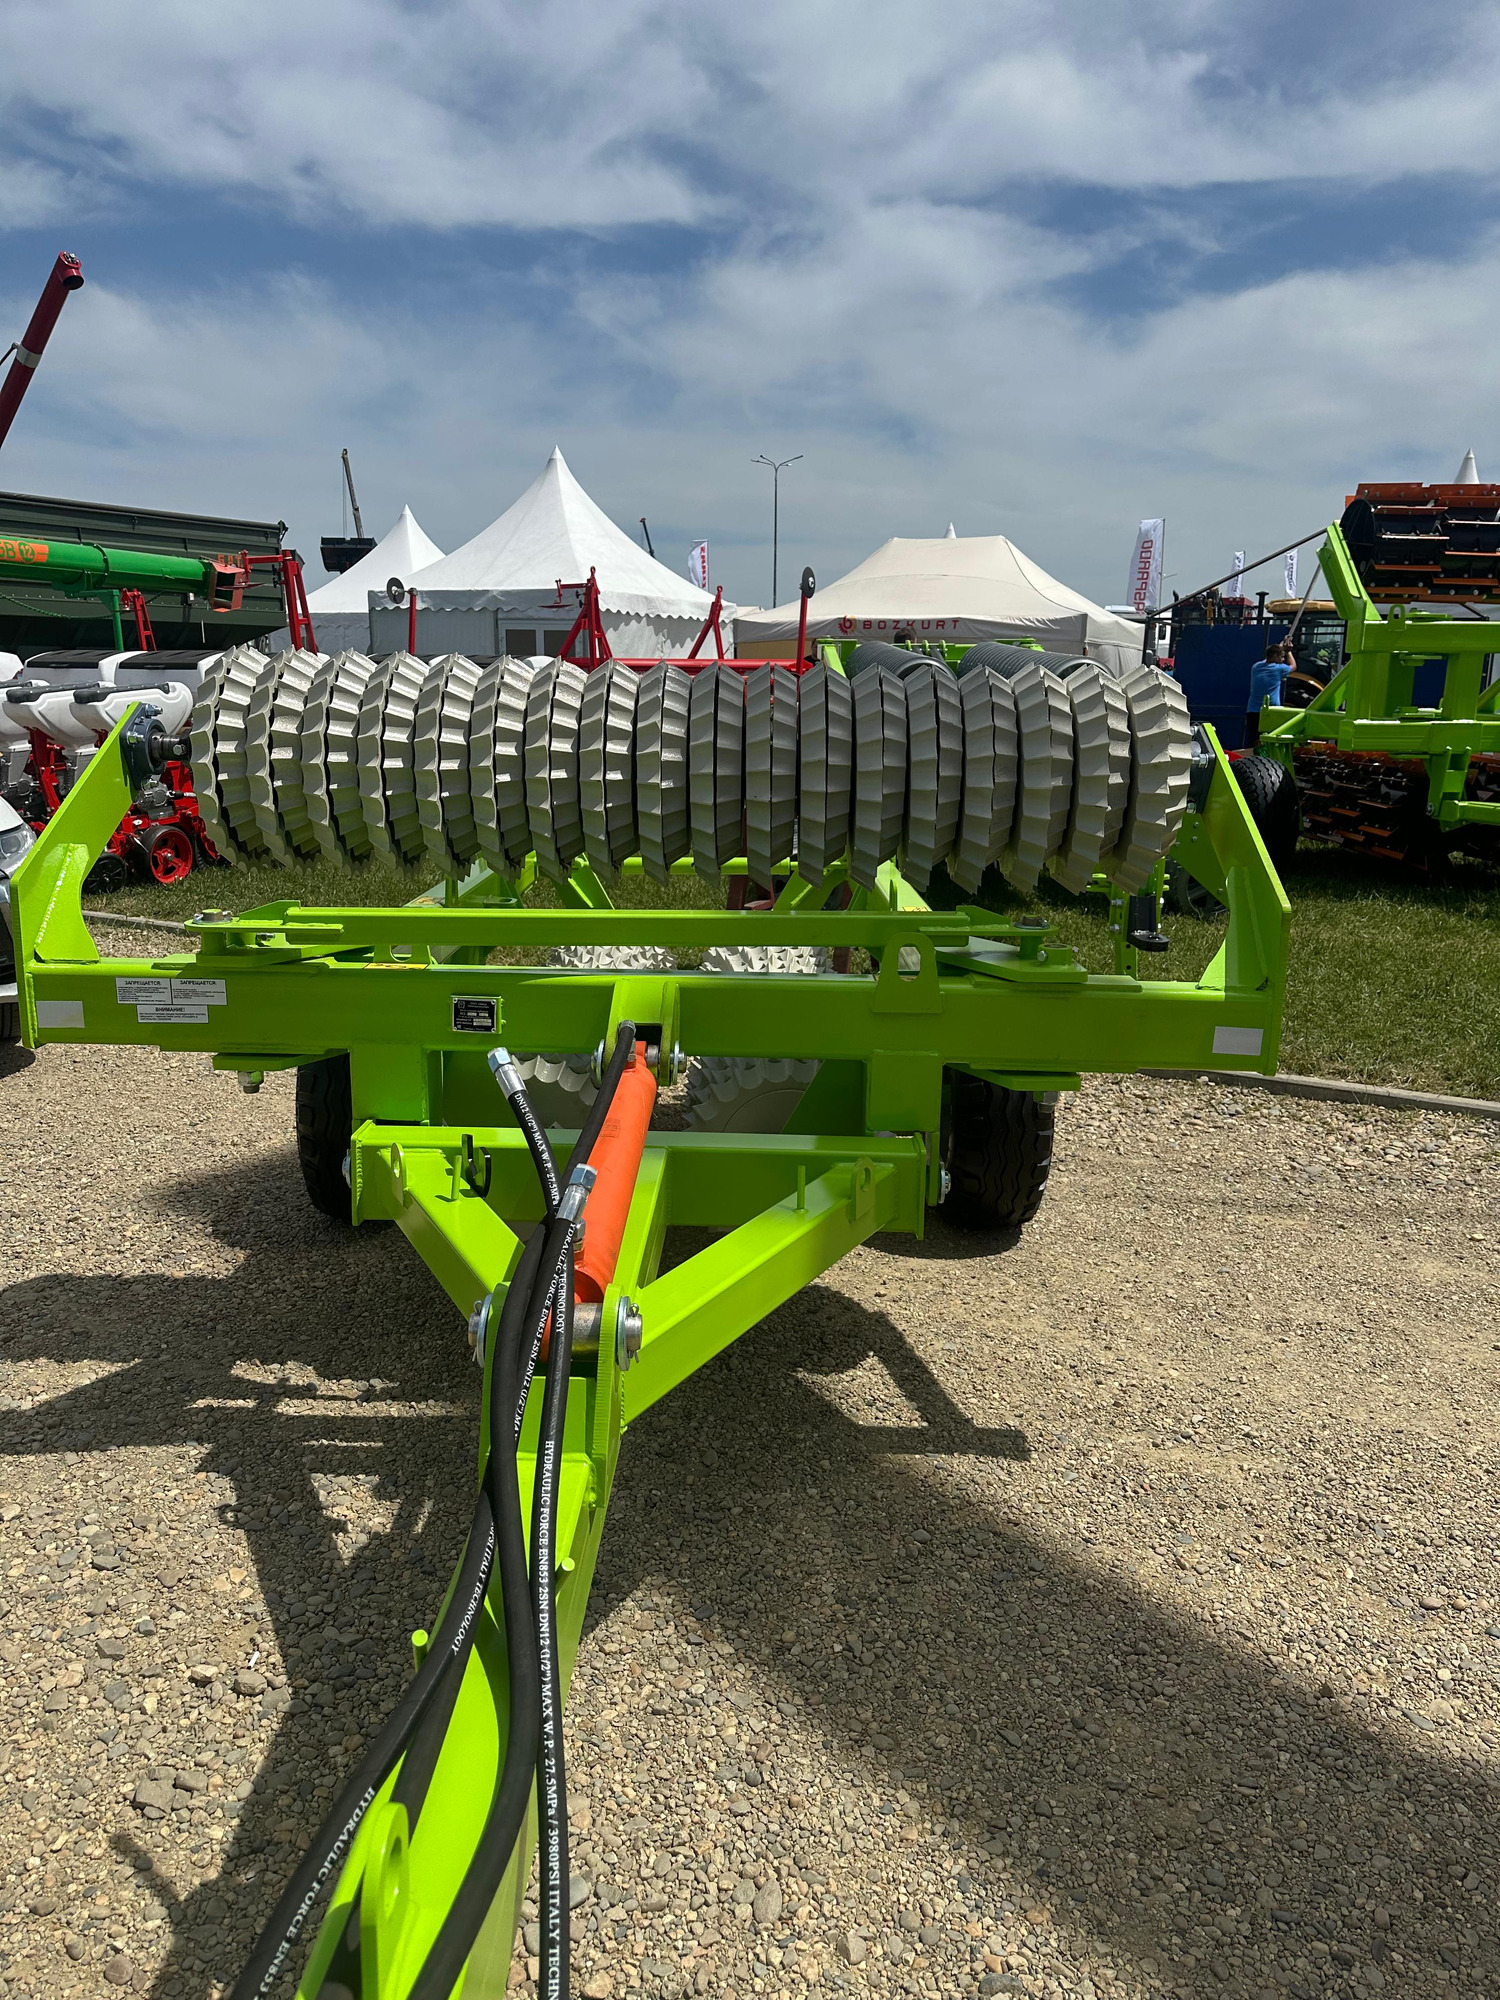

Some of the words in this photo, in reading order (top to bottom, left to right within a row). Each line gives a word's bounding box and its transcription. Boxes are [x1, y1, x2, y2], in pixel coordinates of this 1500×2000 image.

[863, 620, 959, 630] BOZKURT
[514, 1093, 526, 1113] DN12
[533, 1130, 546, 1152] MAX
[540, 1151, 552, 1170] W.P.
[547, 1172, 560, 1205] 27.5MPa
[556, 1223, 577, 1273] YDRAULIC
[547, 1274, 560, 1307] FORCE
[556, 1272, 567, 1333] TECHNOLOGY
[536, 1305, 551, 1338] EN853
[532, 1338, 541, 1358] 2SN
[523, 1357, 536, 1387] DN12
[541, 1440, 555, 1506] HYDRAULIC
[539, 1507, 550, 1546] FORCE
[479, 1549, 493, 1584] ITALY
[538, 1550, 549, 1583] EN853
[538, 1586, 549, 1612] 2SN
[451, 1582, 483, 1656] TECHNOLOGY
[539, 1613, 550, 1646] DN12
[541, 1683, 553, 1718] MAX
[543, 1720, 555, 1753] W.P.
[544, 1757, 557, 1815] 27.5MPa
[318, 1786, 376, 1881] HYDRAULIC
[548, 1827, 560, 1886] 3980PSI
[286, 1880, 321, 1938] FORCE
[548, 1889, 560, 1942] ITALY
[260, 1940, 291, 1993] EN853
